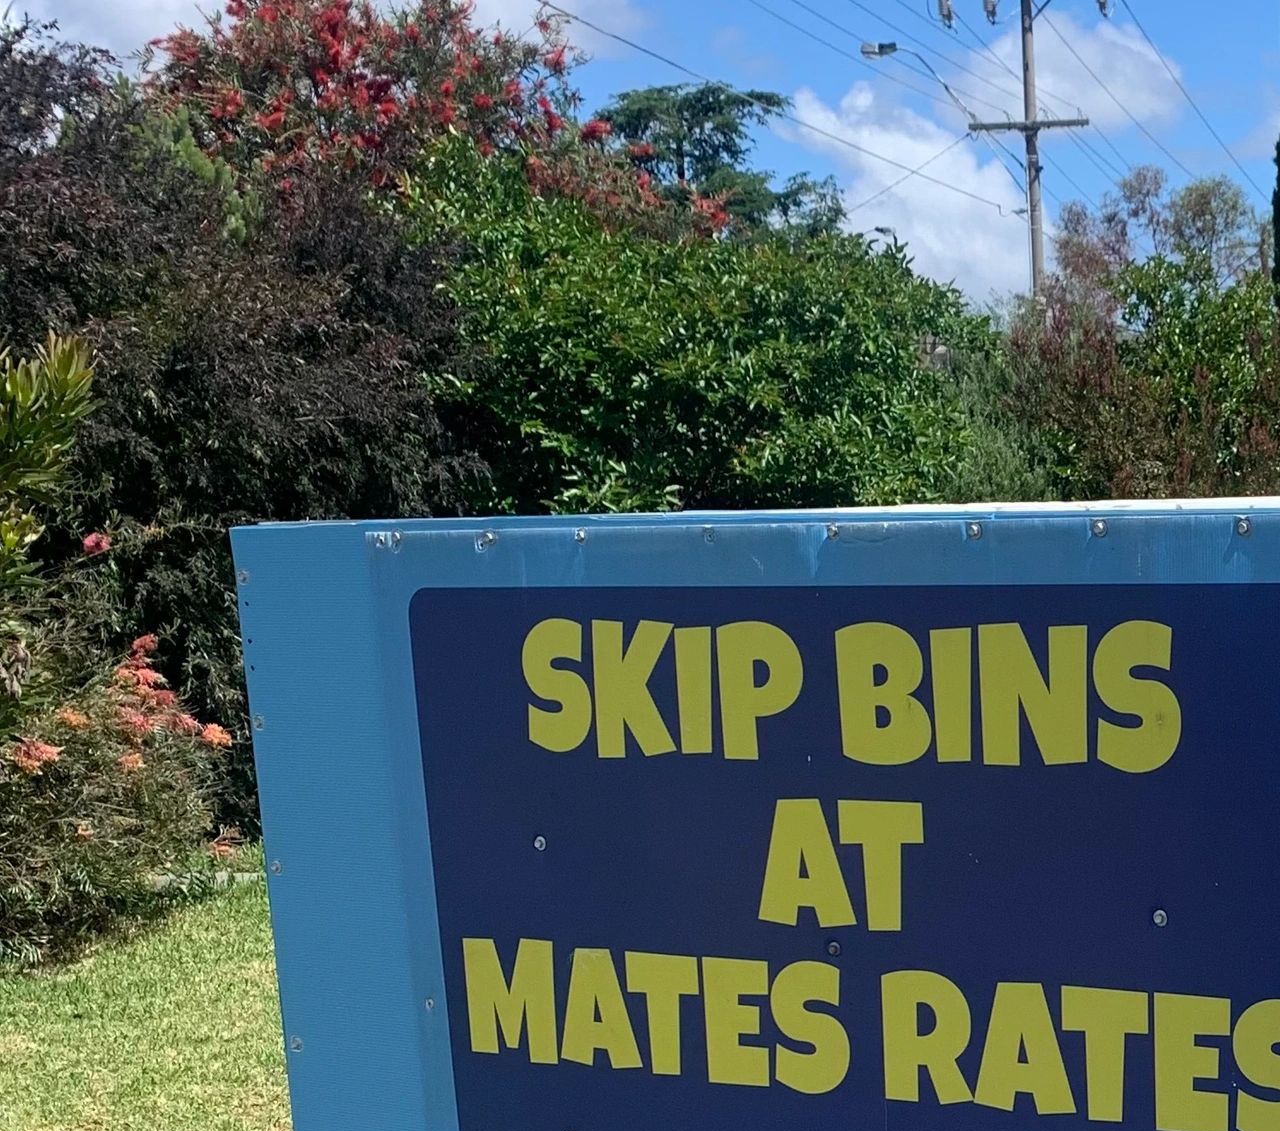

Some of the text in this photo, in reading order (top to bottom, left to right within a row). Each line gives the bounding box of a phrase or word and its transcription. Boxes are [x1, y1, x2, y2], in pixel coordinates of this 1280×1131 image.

[522, 619, 1181, 773] SKIP BINS
[759, 799, 924, 931] AT
[463, 938, 850, 1094] MATES
